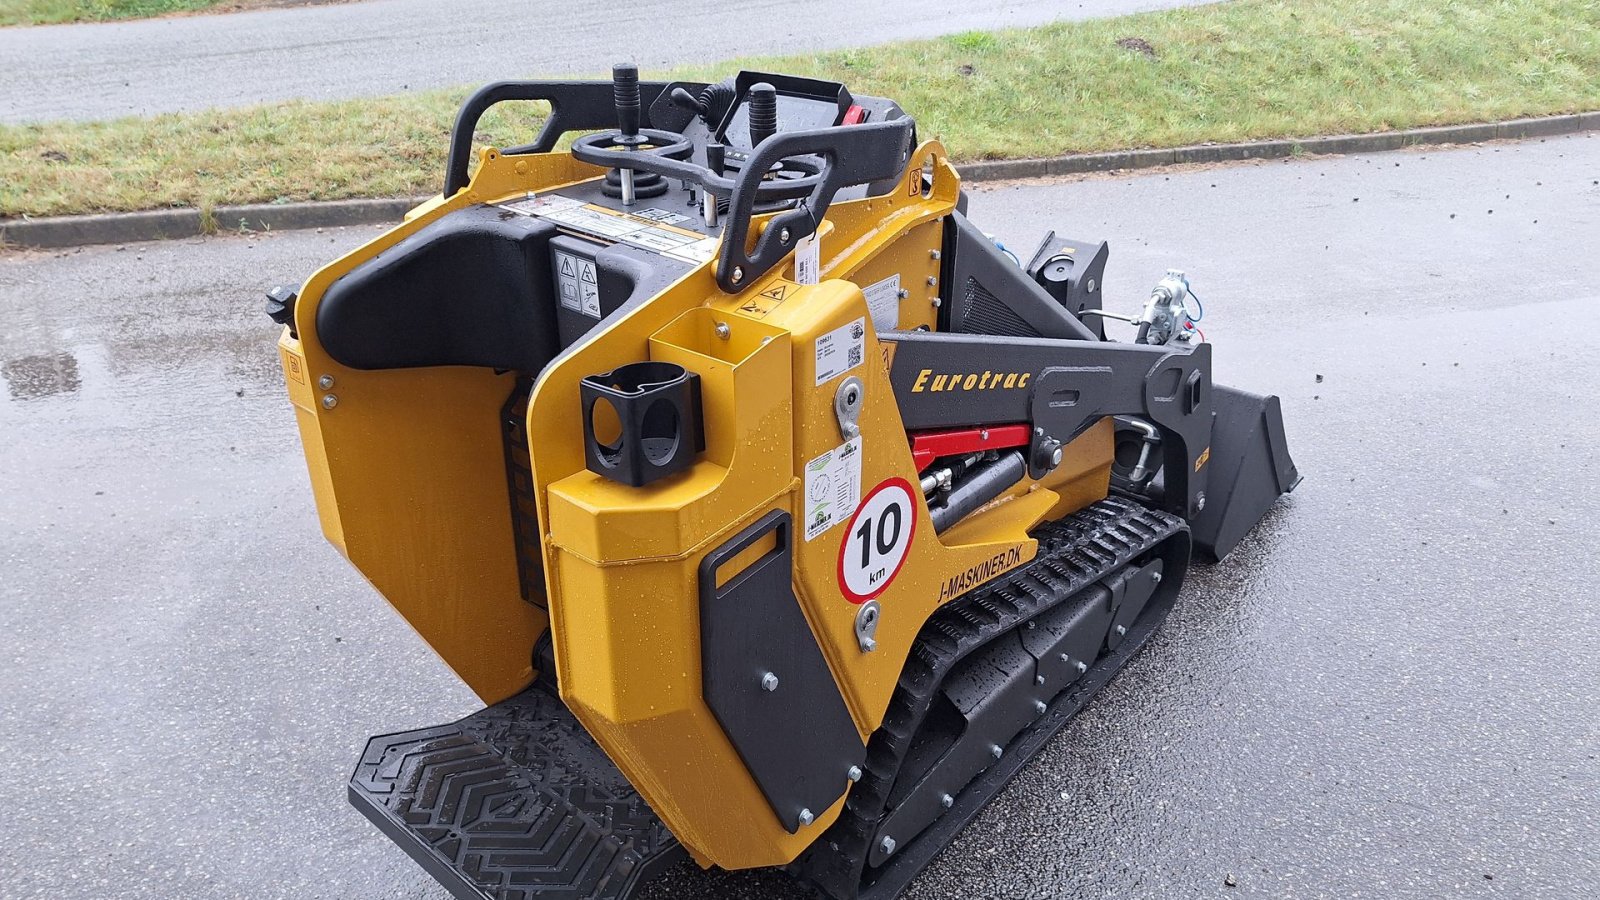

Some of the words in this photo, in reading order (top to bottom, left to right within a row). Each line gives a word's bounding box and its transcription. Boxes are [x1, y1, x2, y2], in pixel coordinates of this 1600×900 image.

[911, 368, 1031, 393] Eurotrac
[857, 502, 902, 569] 10
[869, 567, 886, 586] km
[938, 544, 1023, 603] J-MASKINER.DK
